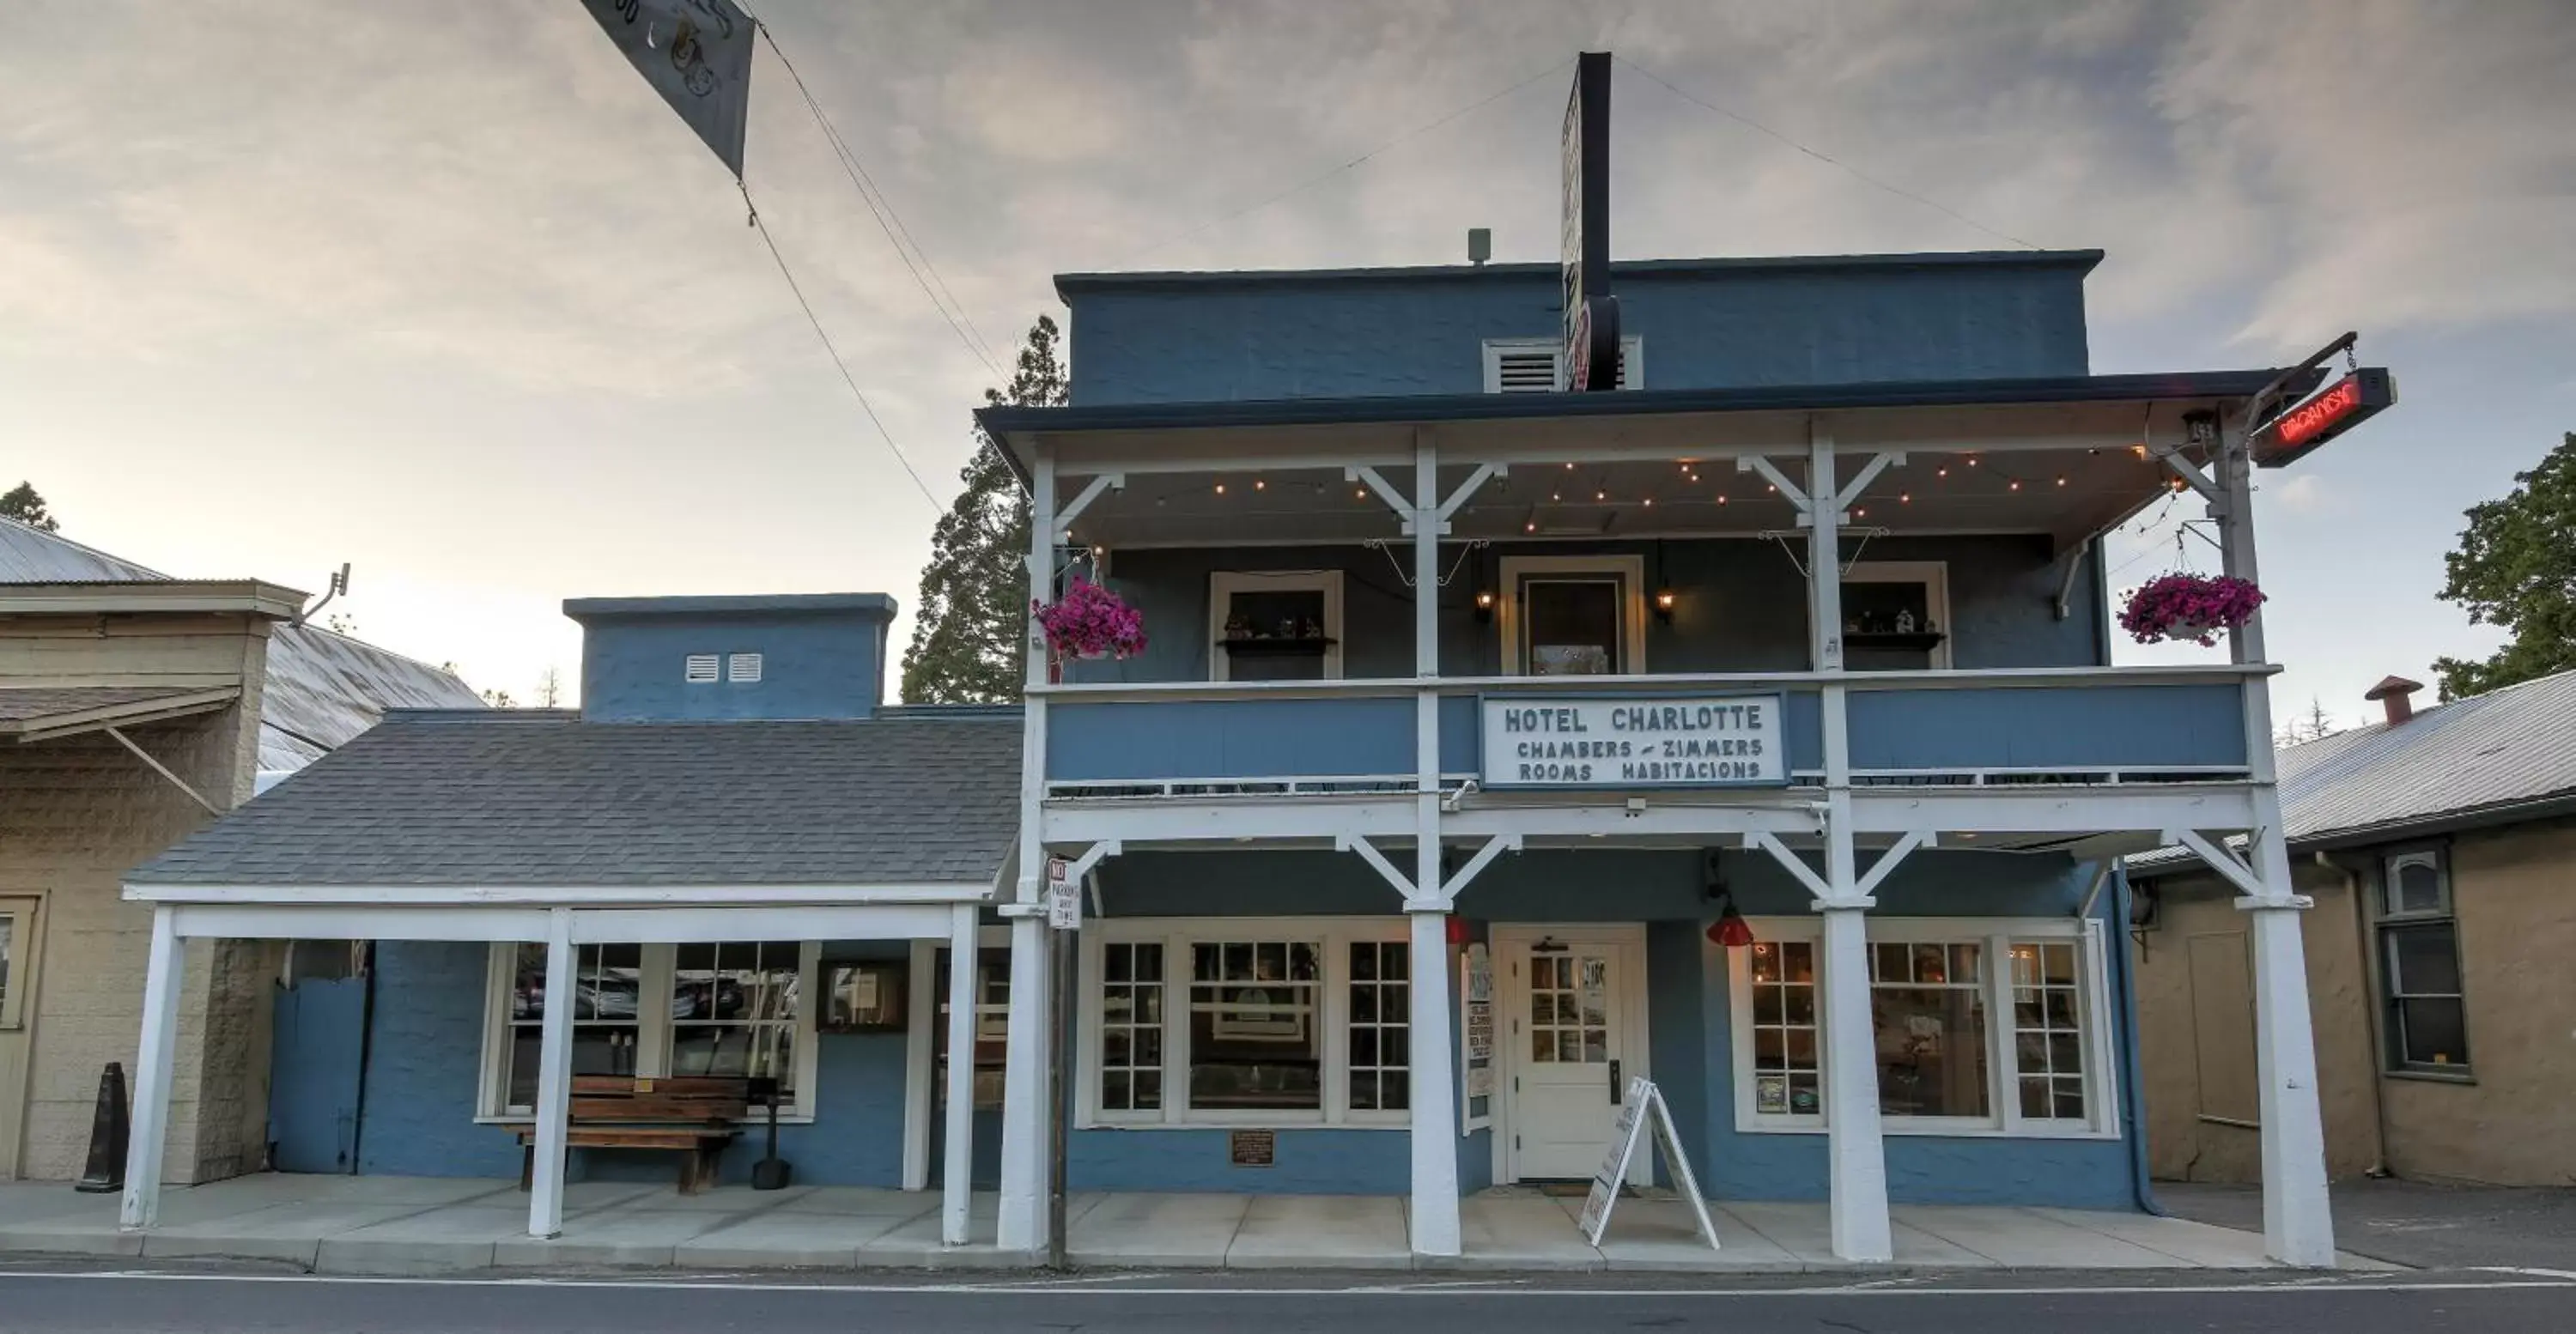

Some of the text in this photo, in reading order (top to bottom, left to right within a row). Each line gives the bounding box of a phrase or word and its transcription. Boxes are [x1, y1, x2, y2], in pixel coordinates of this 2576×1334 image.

[1505, 705, 1763, 732] HOTEL CHARLOTTE
[1517, 740, 1631, 759] CHAMBERS
[1662, 738, 1764, 757] ZIMMERS
[1520, 761, 1760, 782] ROOMS HABITACIONS
[1052, 862, 1064, 878] NO
